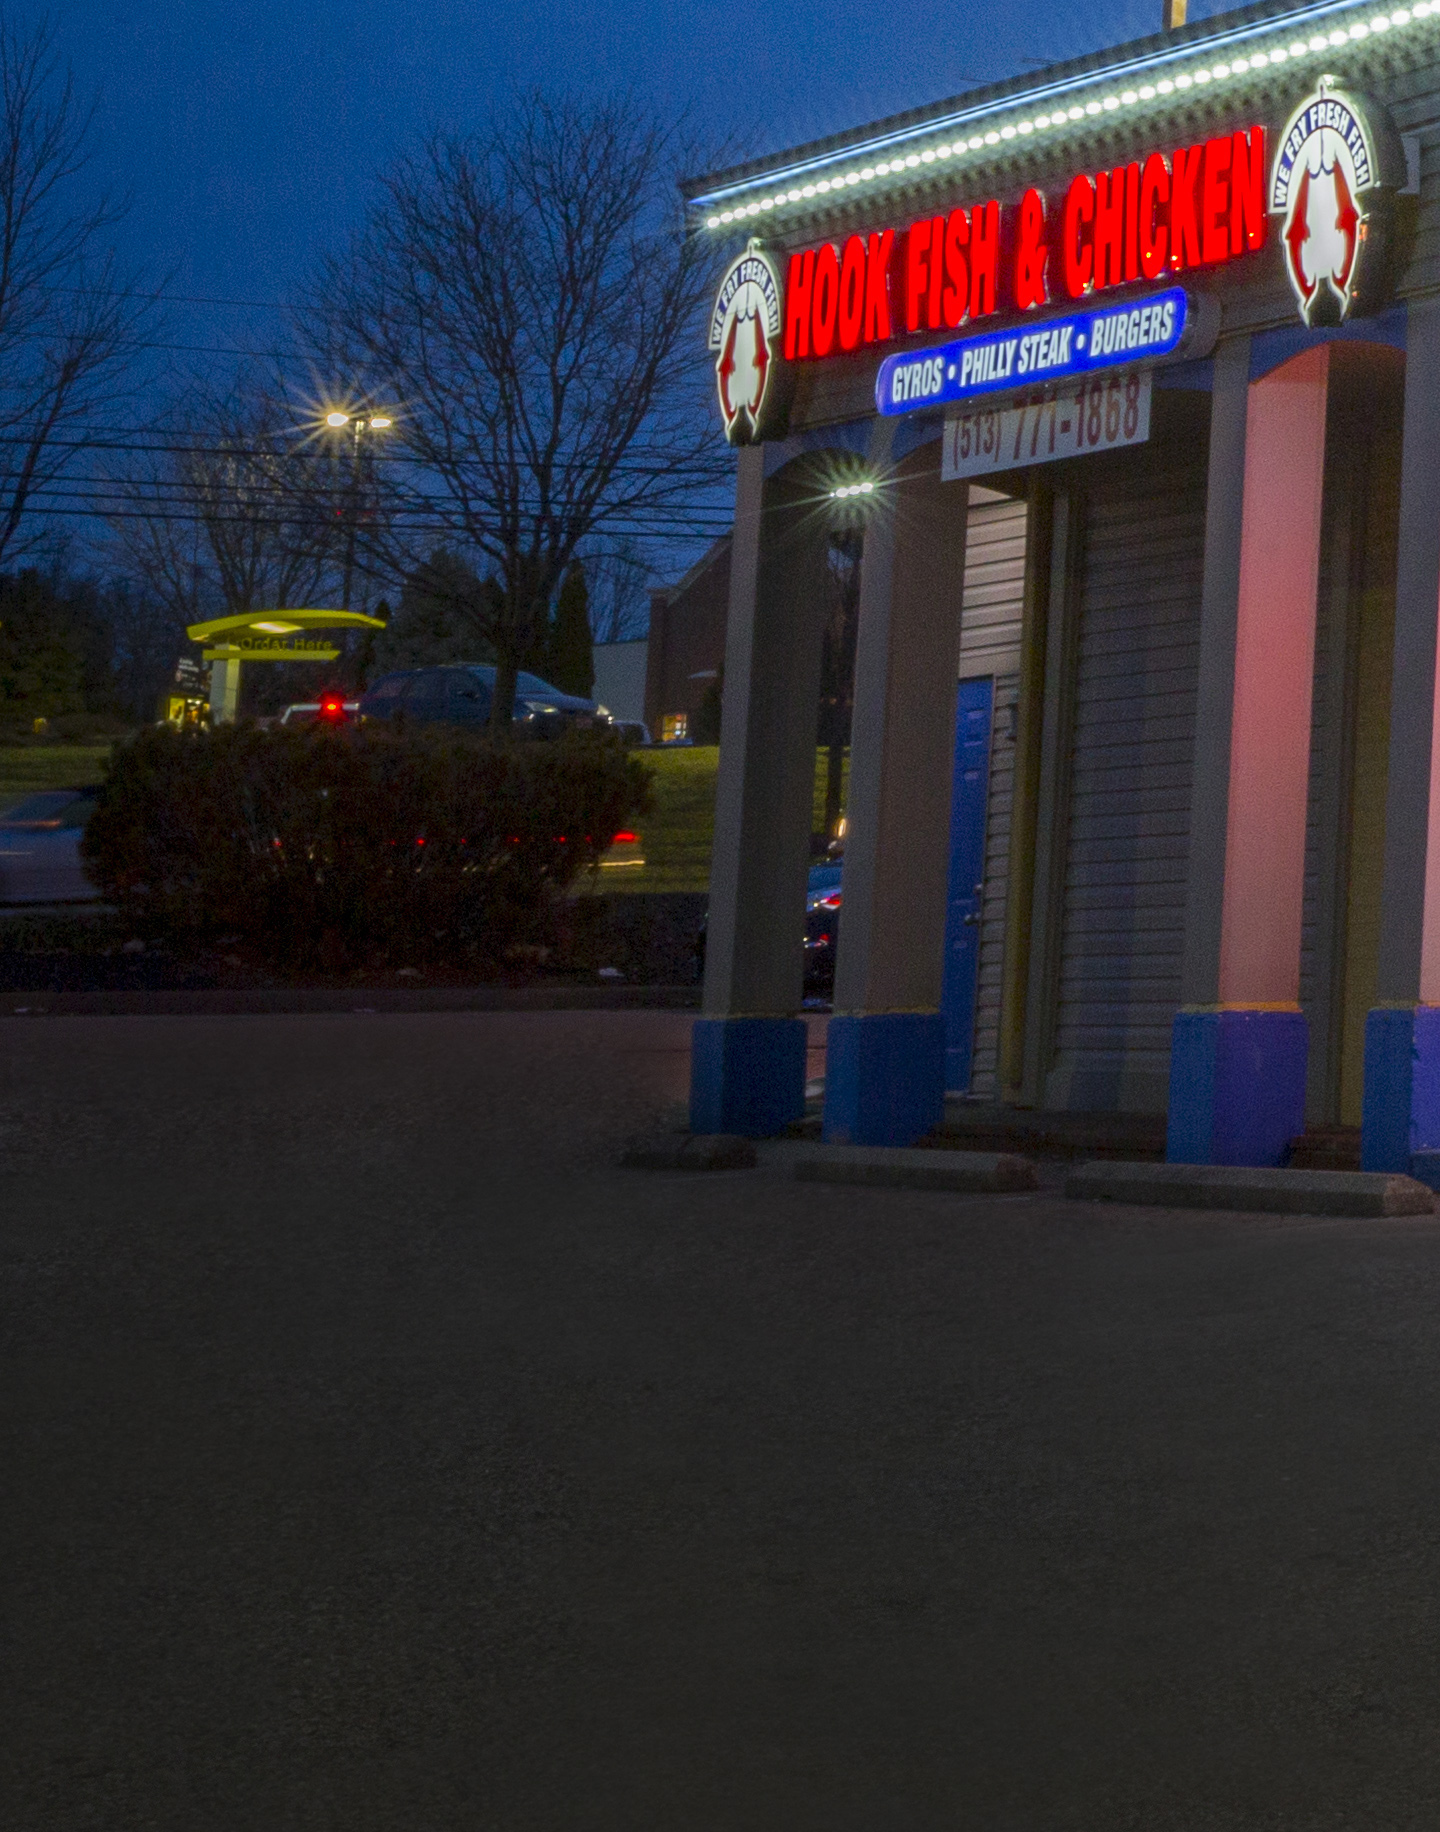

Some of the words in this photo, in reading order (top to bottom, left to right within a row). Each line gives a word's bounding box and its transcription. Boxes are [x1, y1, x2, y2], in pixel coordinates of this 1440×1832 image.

[1274, 164, 1291, 204] WE
[1285, 116, 1309, 163] FRY
[1310, 102, 1351, 137] FRESH
[1347, 126, 1371, 186] FISH
[784, 228, 895, 361] HOOK
[906, 199, 1001, 333] FISH
[1016, 188, 1047, 310] &
[1063, 125, 1267, 299] CHICKEN
[711, 309, 725, 342] WE
[721, 270, 739, 308] FRY
[740, 260, 770, 289] FRESH
[764, 281, 779, 333] FISH
[891, 357, 943, 403] GYROS
[960, 339, 1019, 387] PHILLY
[1016, 326, 1073, 375] STEAK
[1090, 302, 1176, 356] BURGERS
[952, 407, 1001, 470] (513)
[1012, 374, 1142, 461] 771-1868
[240, 637, 289, 650] Order
[294, 639, 333, 650] Here
